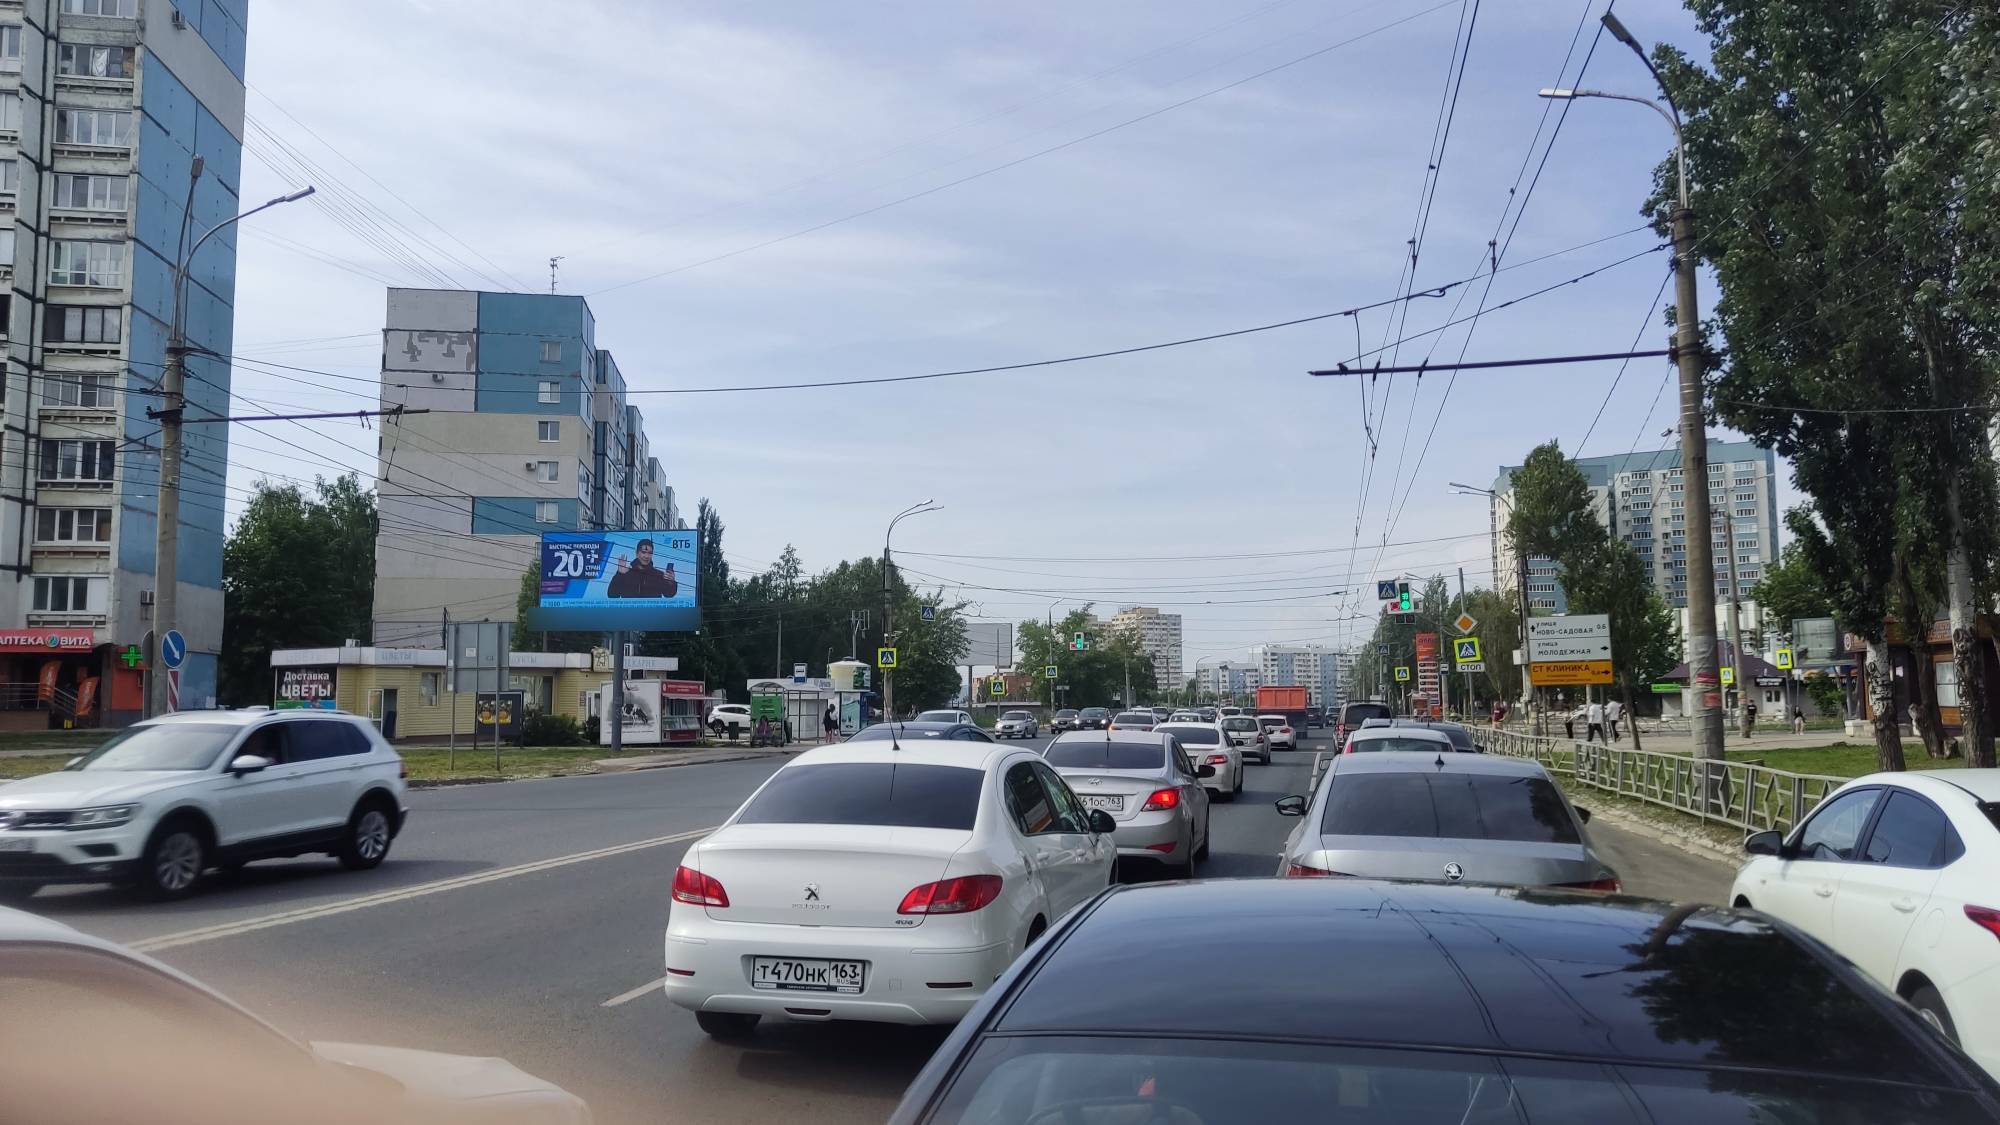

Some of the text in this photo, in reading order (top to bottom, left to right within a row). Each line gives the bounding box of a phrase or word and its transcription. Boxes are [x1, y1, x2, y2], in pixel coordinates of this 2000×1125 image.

[672, 539, 691, 549] ВТБ
[1536, 627, 1593, 636] НОВО-САДОВАЯ
[60, 636, 91, 645] ВИТА
[1537, 648, 1592, 657] МОЛОДЕЖНАЯ
[1546, 664, 1591, 674] КЛИНИКА
[283, 671, 330, 682] Доставка
[281, 684, 331, 698] ЦВЕТЫ
[1107, 797, 1121, 805] 763
[759, 961, 857, 983] Т470НК 163
